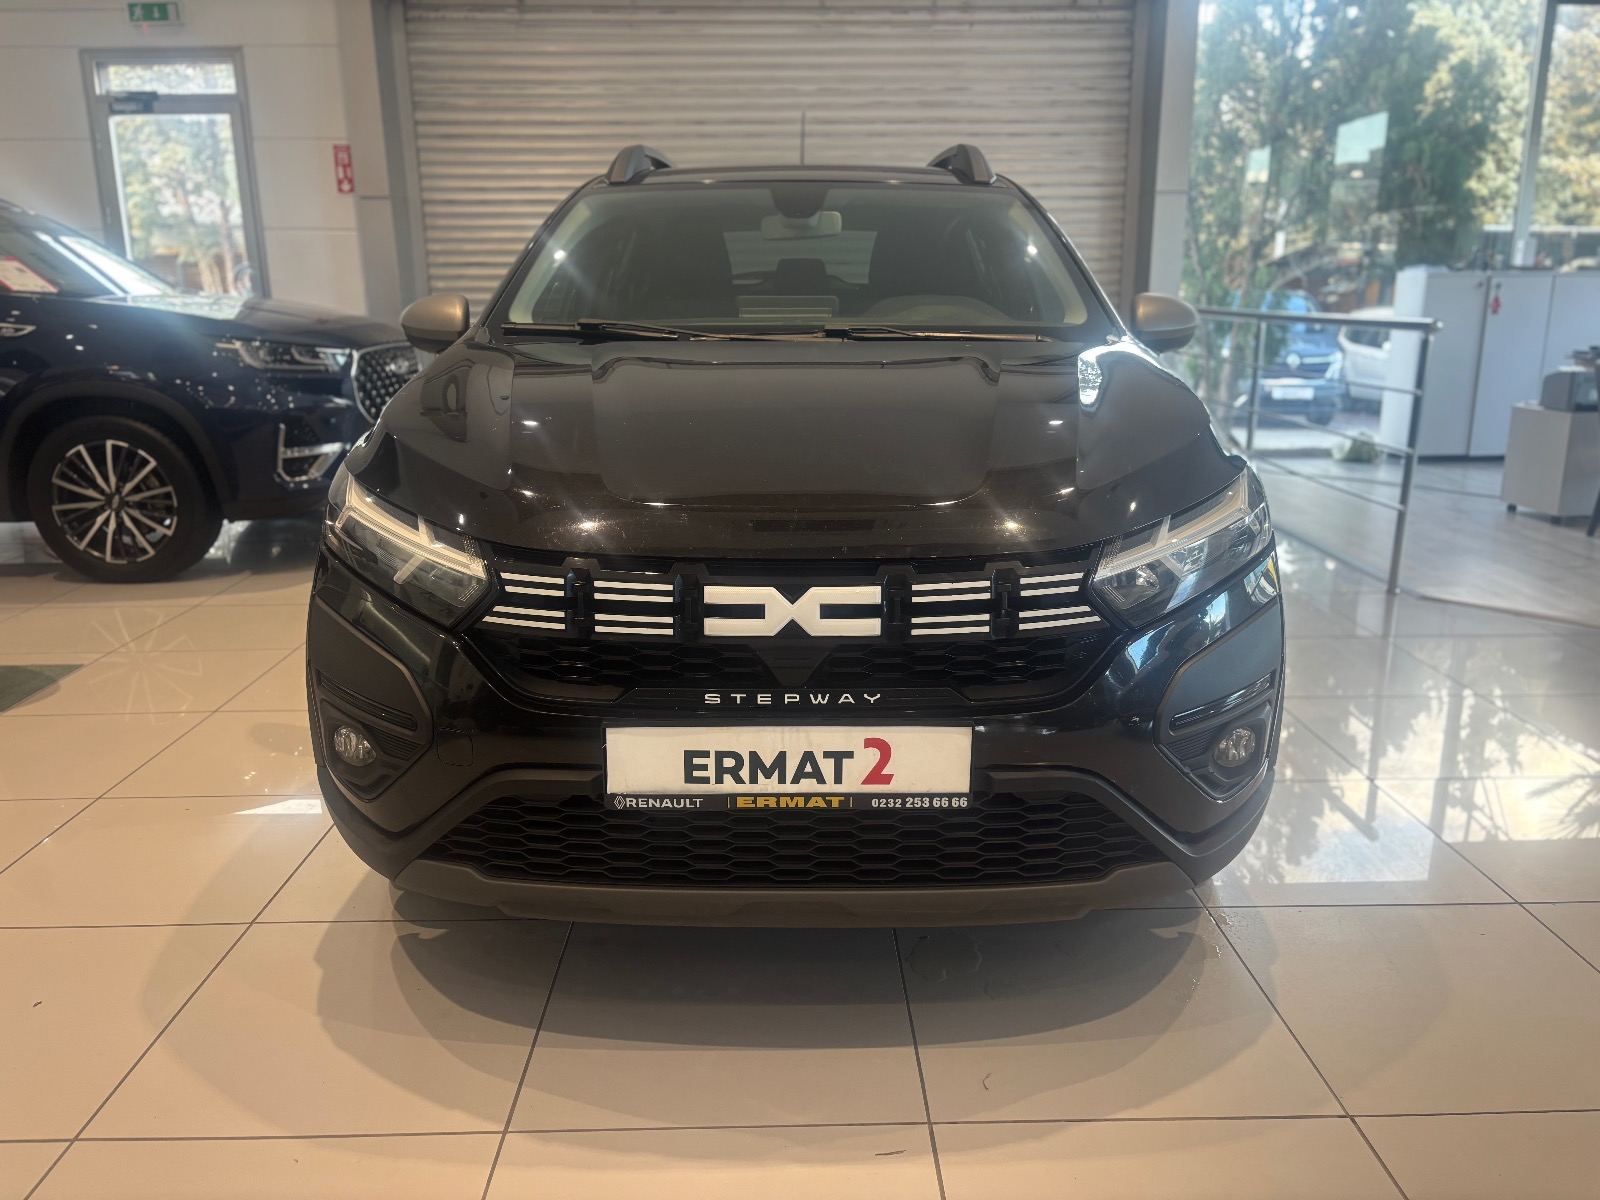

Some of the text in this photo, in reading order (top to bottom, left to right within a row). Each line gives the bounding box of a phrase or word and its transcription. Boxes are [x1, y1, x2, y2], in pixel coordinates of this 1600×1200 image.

[703, 693, 881, 705] STEPWAY
[625, 798, 704, 809] RENAULT
[736, 796, 845, 808] ERMAT
[871, 796, 968, 808] 0232 253 66 66
